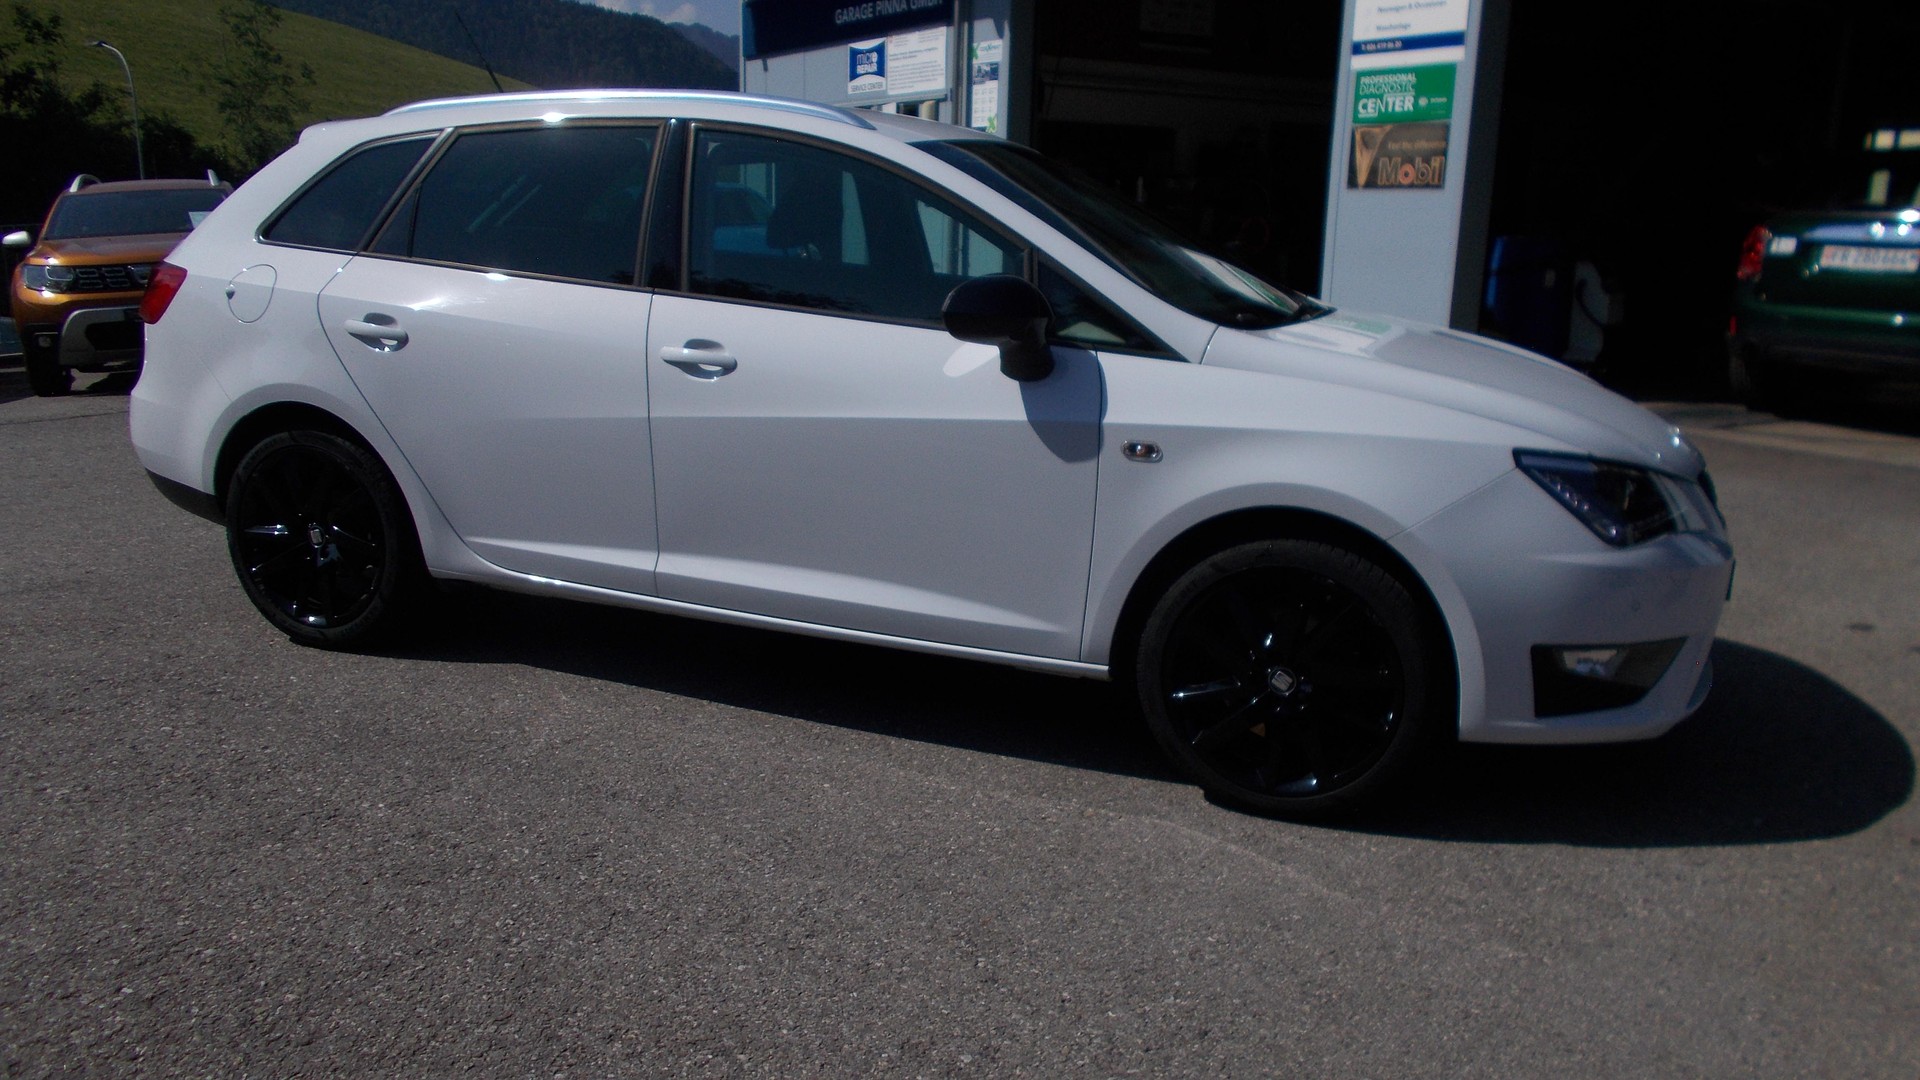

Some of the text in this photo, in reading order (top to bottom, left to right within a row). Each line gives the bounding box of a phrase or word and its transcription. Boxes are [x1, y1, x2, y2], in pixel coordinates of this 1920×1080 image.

[835, 2, 873, 24] GARAGE
[876, 0, 907, 16] PINNA
[1360, 72, 1417, 84] PROFESSIONAL
[1360, 81, 1414, 95] DIAGNOSTIC
[1358, 94, 1415, 114] CENTER
[1378, 155, 1445, 185] Mobil
